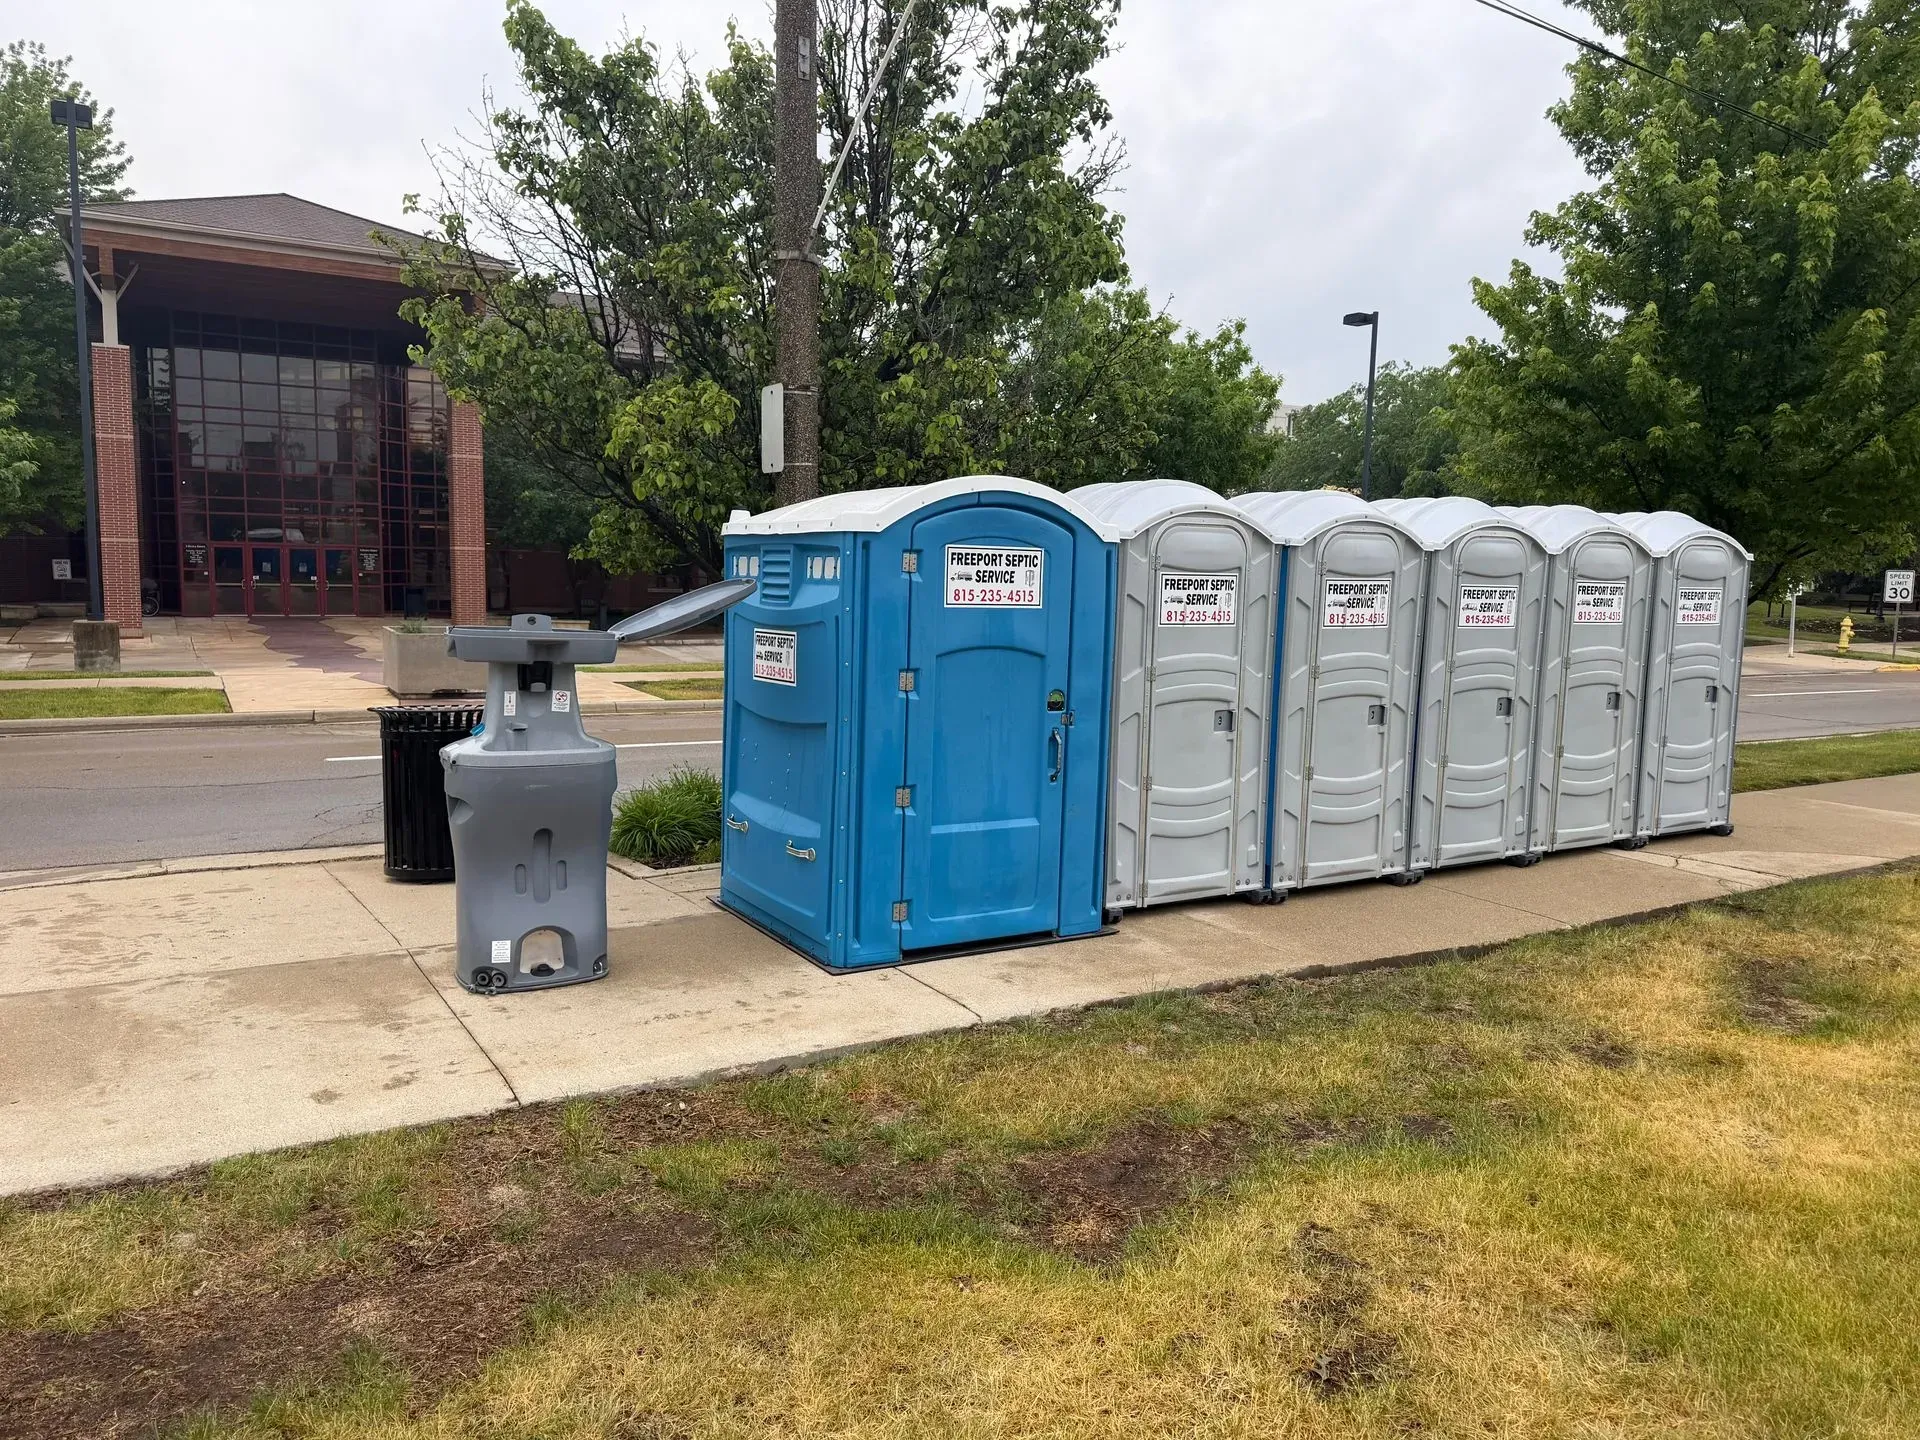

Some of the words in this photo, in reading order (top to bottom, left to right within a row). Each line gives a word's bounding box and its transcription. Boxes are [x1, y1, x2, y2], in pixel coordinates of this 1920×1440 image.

[951, 552, 1003, 566] FREEPORT
[1005, 554, 1039, 568] SEPTIC
[975, 570, 1016, 583] SERVICE
[1164, 579, 1210, 591] FREEPORT
[1210, 579, 1235, 591] SEPTIC
[1328, 584, 1367, 595] FREEPORT
[1368, 584, 1388, 595] SEPTIC
[1577, 585, 1609, 595] FREEPORT
[1609, 586, 1624, 595] SEPTIC
[953, 589, 1034, 602] 815-235-4515
[1463, 589, 1497, 599] FREEPORT
[1498, 590, 1515, 600] SEPTIC
[1680, 591, 1707, 600] FREEPORT
[1888, 587, 1910, 599] 30
[1186, 594, 1218, 605] SERVICE
[1346, 597, 1374, 608] SERVICE
[1592, 598, 1614, 607] SERVICE
[1479, 602, 1504, 612] SERVICE
[1693, 603, 1712, 611] SERVICE
[1166, 611, 1231, 622] 815-235-4515
[1329, 613, 1384, 624] 815-235-4515
[1465, 615, 1510, 624] 815-235-4515
[1578, 611, 1621, 620] 815-235-4515
[1682, 614, 1717, 622] 815-235-4515
[756, 634, 776, 647] FREEPORT
[777, 637, 794, 649] SEPTIC
[764, 650, 783, 663] SERVICE
[756, 663, 793, 679] 815-235-4515
